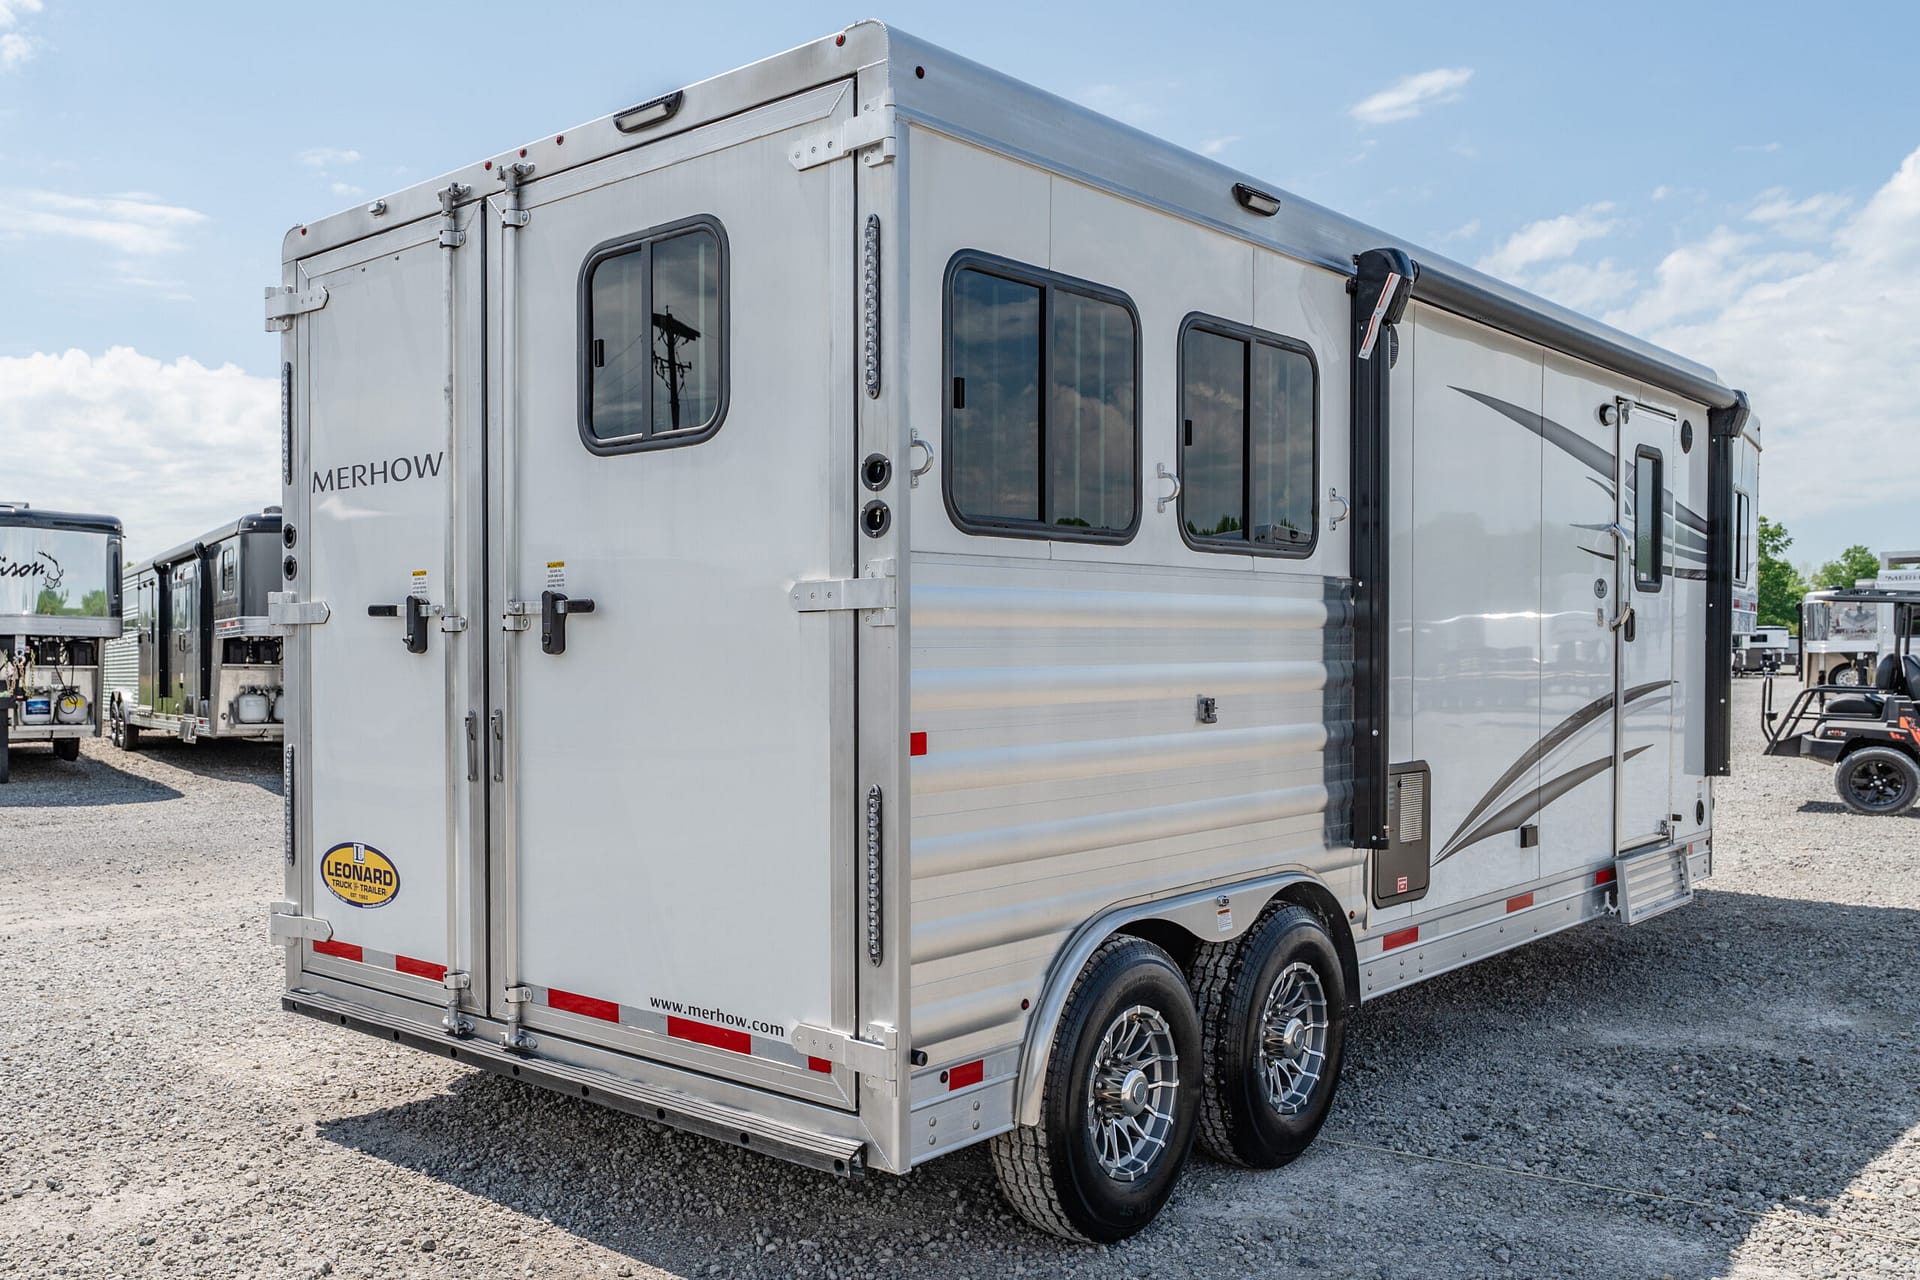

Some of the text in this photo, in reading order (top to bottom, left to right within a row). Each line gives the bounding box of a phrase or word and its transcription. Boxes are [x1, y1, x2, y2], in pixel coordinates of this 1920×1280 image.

[312, 451, 443, 494] MERHOW
[0, 556, 45, 578] ison
[327, 860, 393, 887] LEONARD
[332, 879, 353, 890] TRUCK
[360, 884, 387, 896] TRAILER
[650, 996, 785, 1037] www.merhow.com
